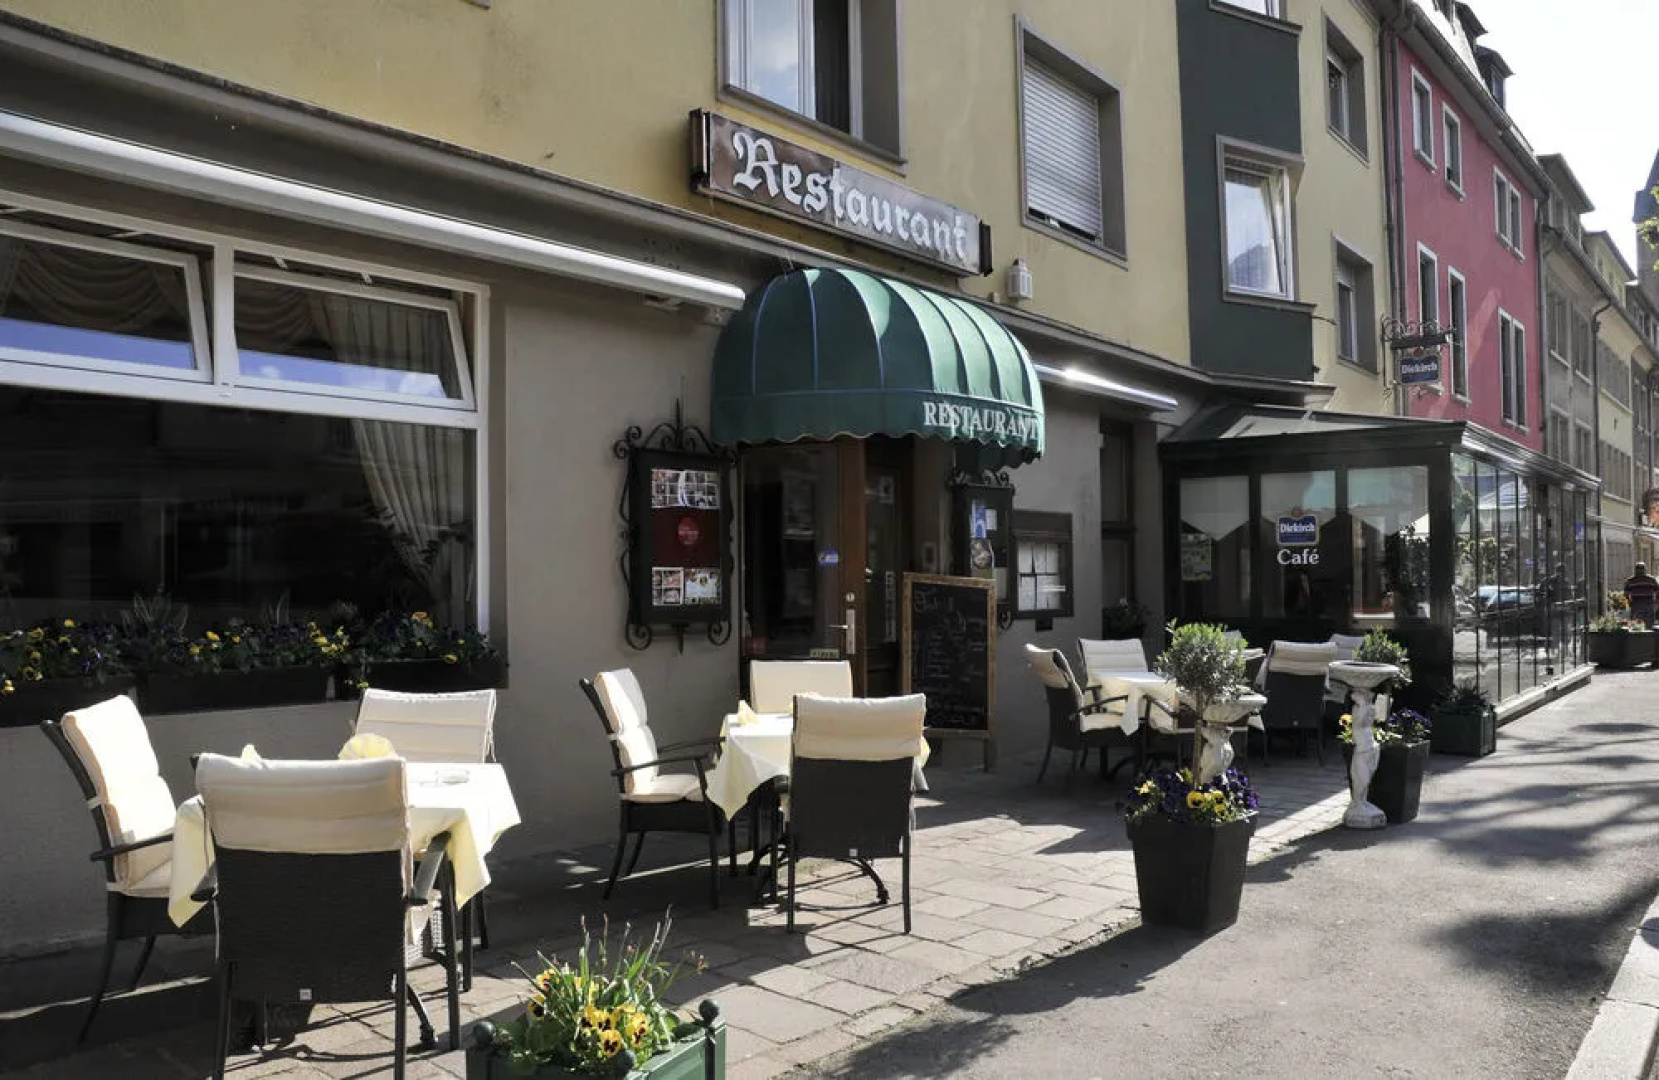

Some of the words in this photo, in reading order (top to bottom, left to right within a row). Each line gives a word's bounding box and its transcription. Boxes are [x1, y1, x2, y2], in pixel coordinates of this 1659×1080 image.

[732, 131, 968, 258] Restaurant
[923, 400, 1039, 440] RESTAURANT
[1277, 548, 1320, 565] Café
